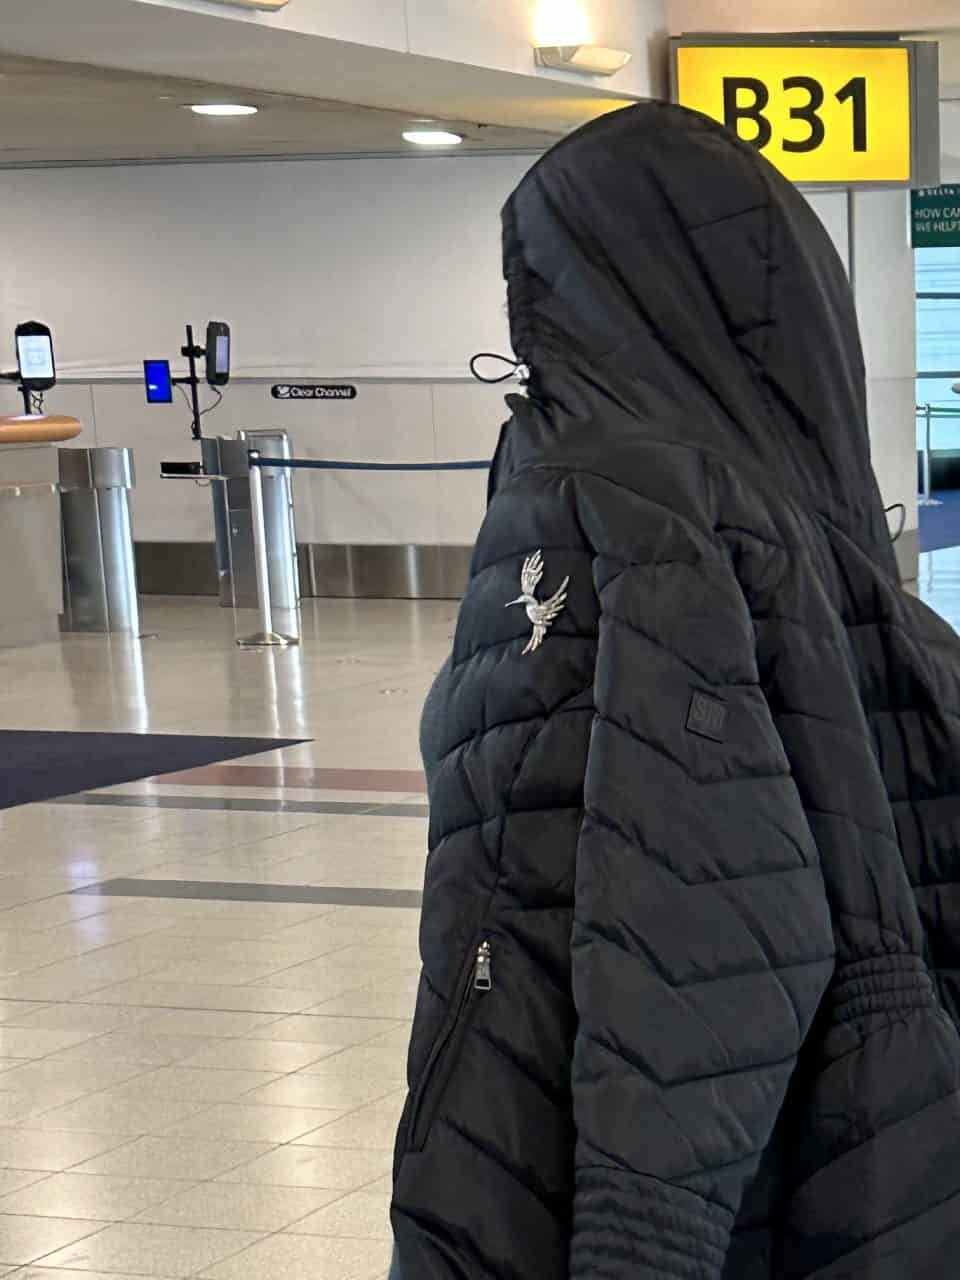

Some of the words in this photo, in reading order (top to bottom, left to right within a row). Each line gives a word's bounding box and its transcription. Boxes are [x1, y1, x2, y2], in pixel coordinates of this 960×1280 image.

[723, 76, 867, 153] B31
[914, 208, 940, 218] HOW
[914, 221, 930, 232] WE
[290, 386, 314, 397] Clear
[315, 386, 352, 397] Channel
